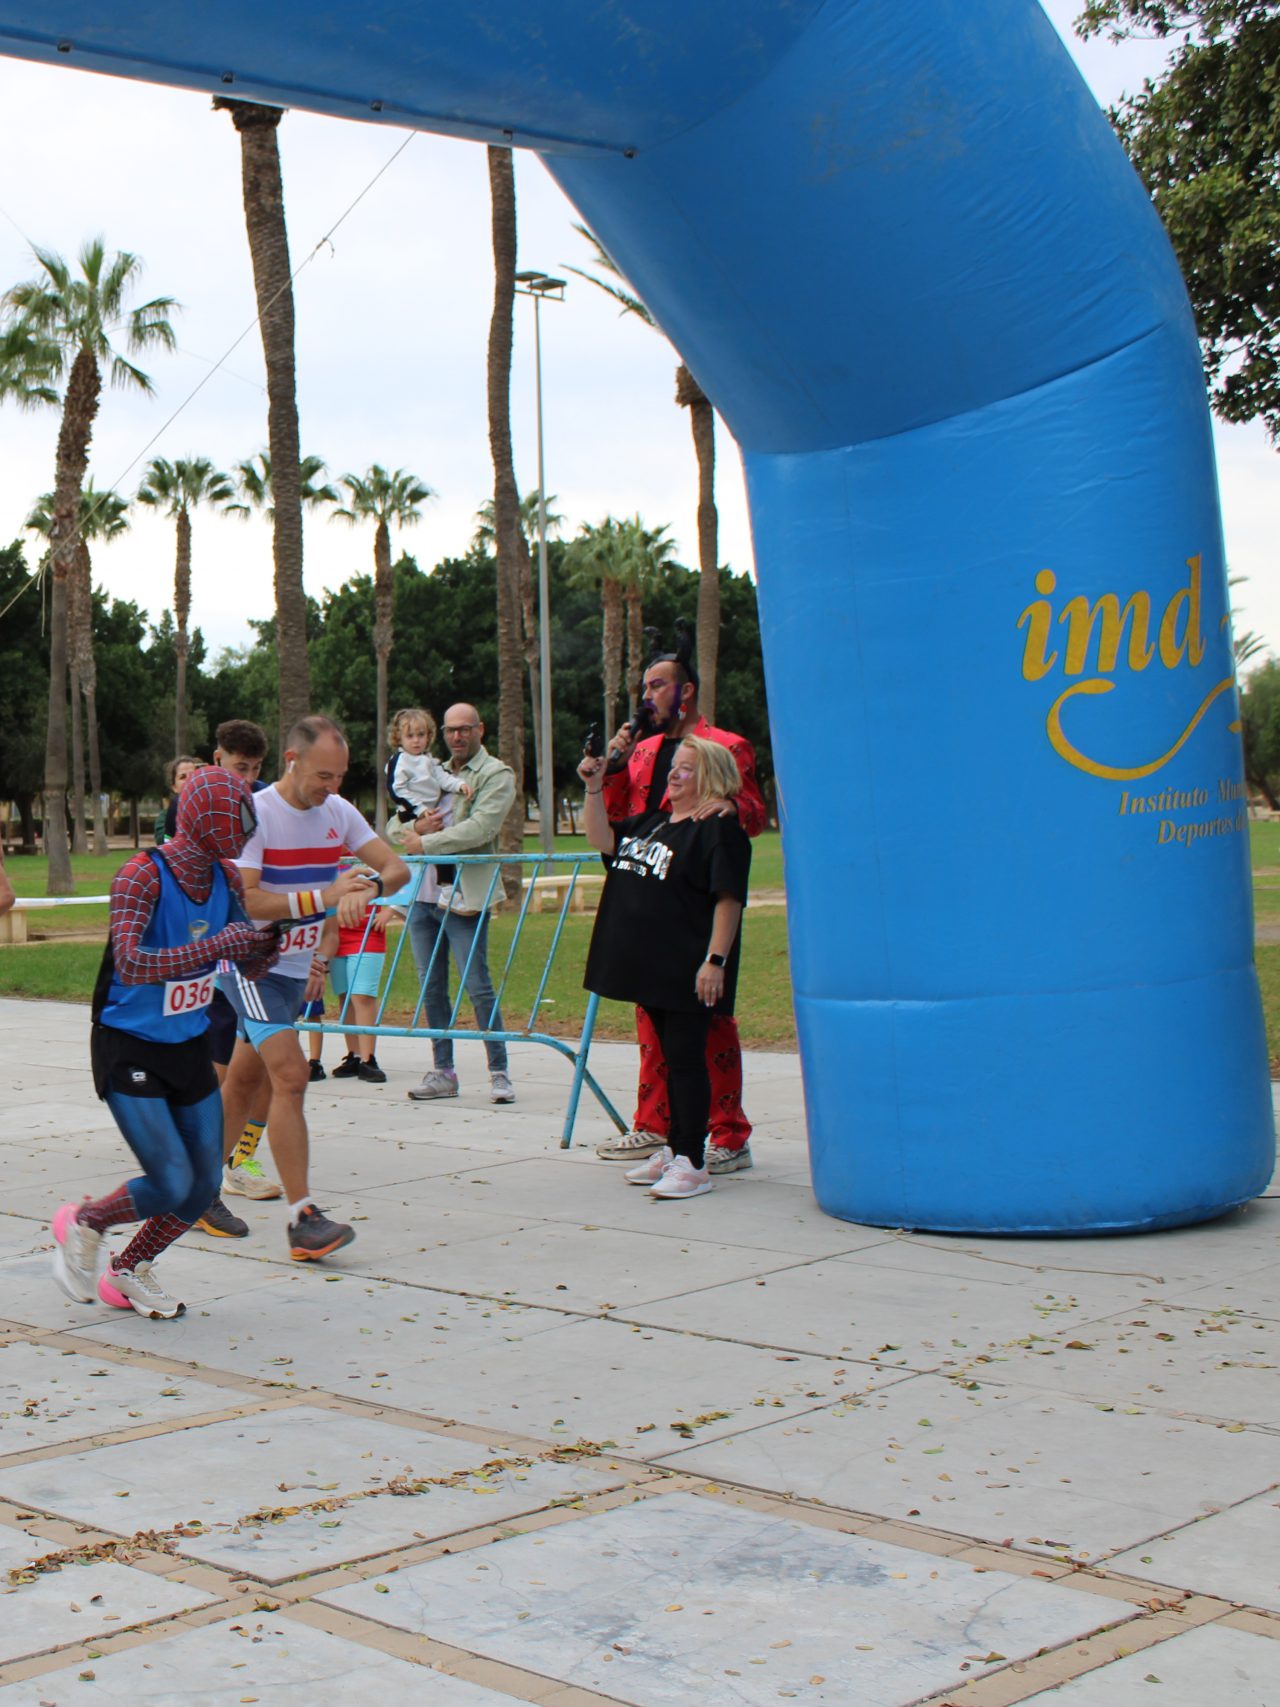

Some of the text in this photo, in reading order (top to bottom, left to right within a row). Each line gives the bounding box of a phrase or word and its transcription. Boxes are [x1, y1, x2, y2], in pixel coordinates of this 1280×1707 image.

[1017, 552, 1206, 682] imd
[1118, 785, 1209, 816] Instituto
[1156, 816, 1233, 848] Deportes
[278, 925, 320, 953] 043
[169, 977, 213, 1012] 036
